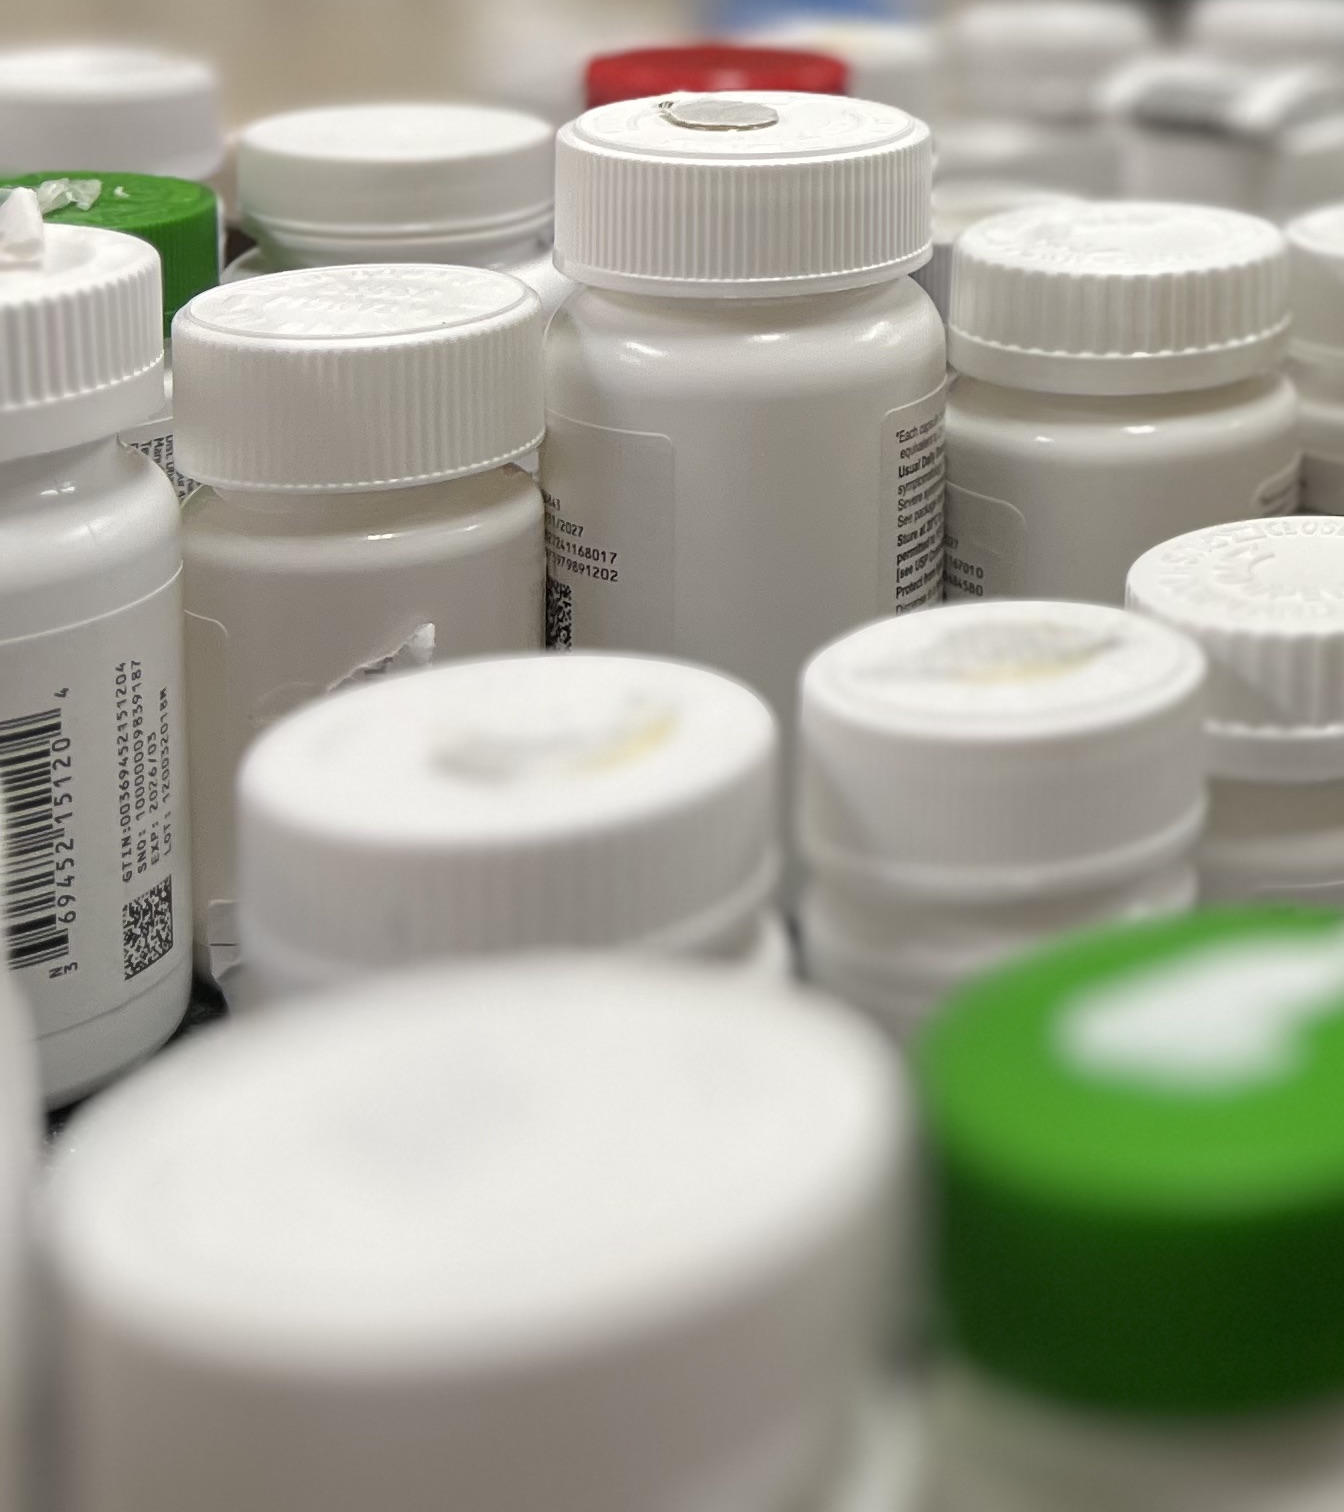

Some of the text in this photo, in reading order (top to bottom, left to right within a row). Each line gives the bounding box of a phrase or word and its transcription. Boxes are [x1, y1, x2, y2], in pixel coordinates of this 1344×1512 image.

[54, 687, 69, 699] 4
[51, 737, 73, 824] 15120
[55, 837, 77, 925] 69452
